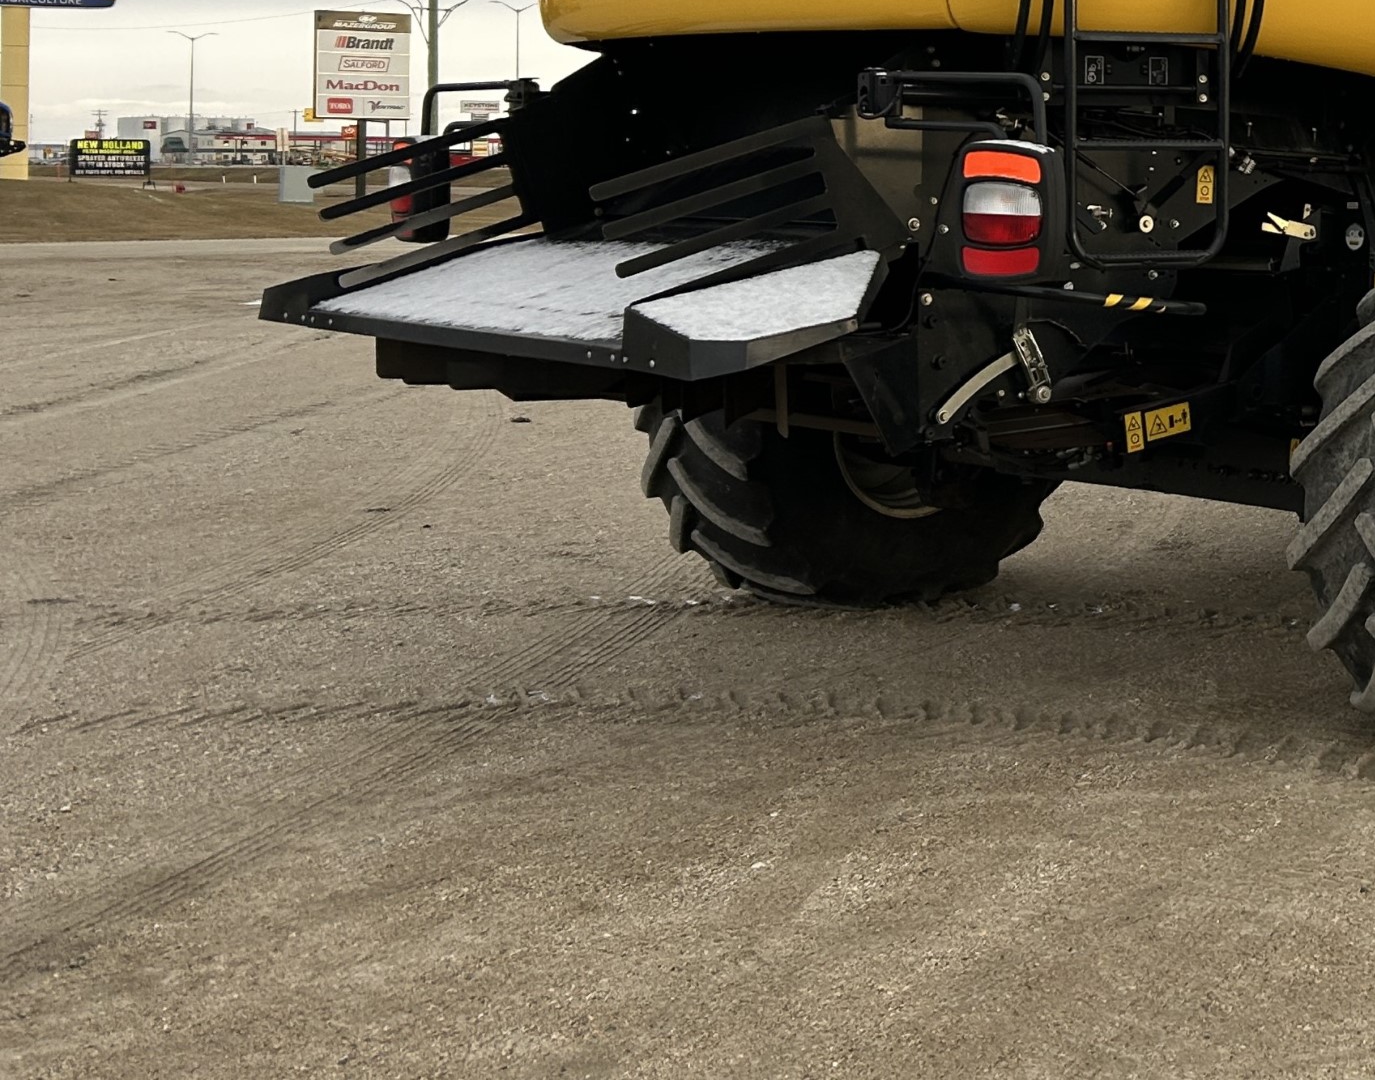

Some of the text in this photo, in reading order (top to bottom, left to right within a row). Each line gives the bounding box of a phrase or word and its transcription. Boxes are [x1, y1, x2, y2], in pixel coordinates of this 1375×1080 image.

[332, 21, 397, 30] MAZERGROUP
[345, 36, 395, 50] Brandt
[343, 59, 386, 69] SALFORD
[326, 79, 400, 91] MacDon
[329, 102, 351, 110] TORO
[77, 140, 144, 149] NEW HOLLAND
